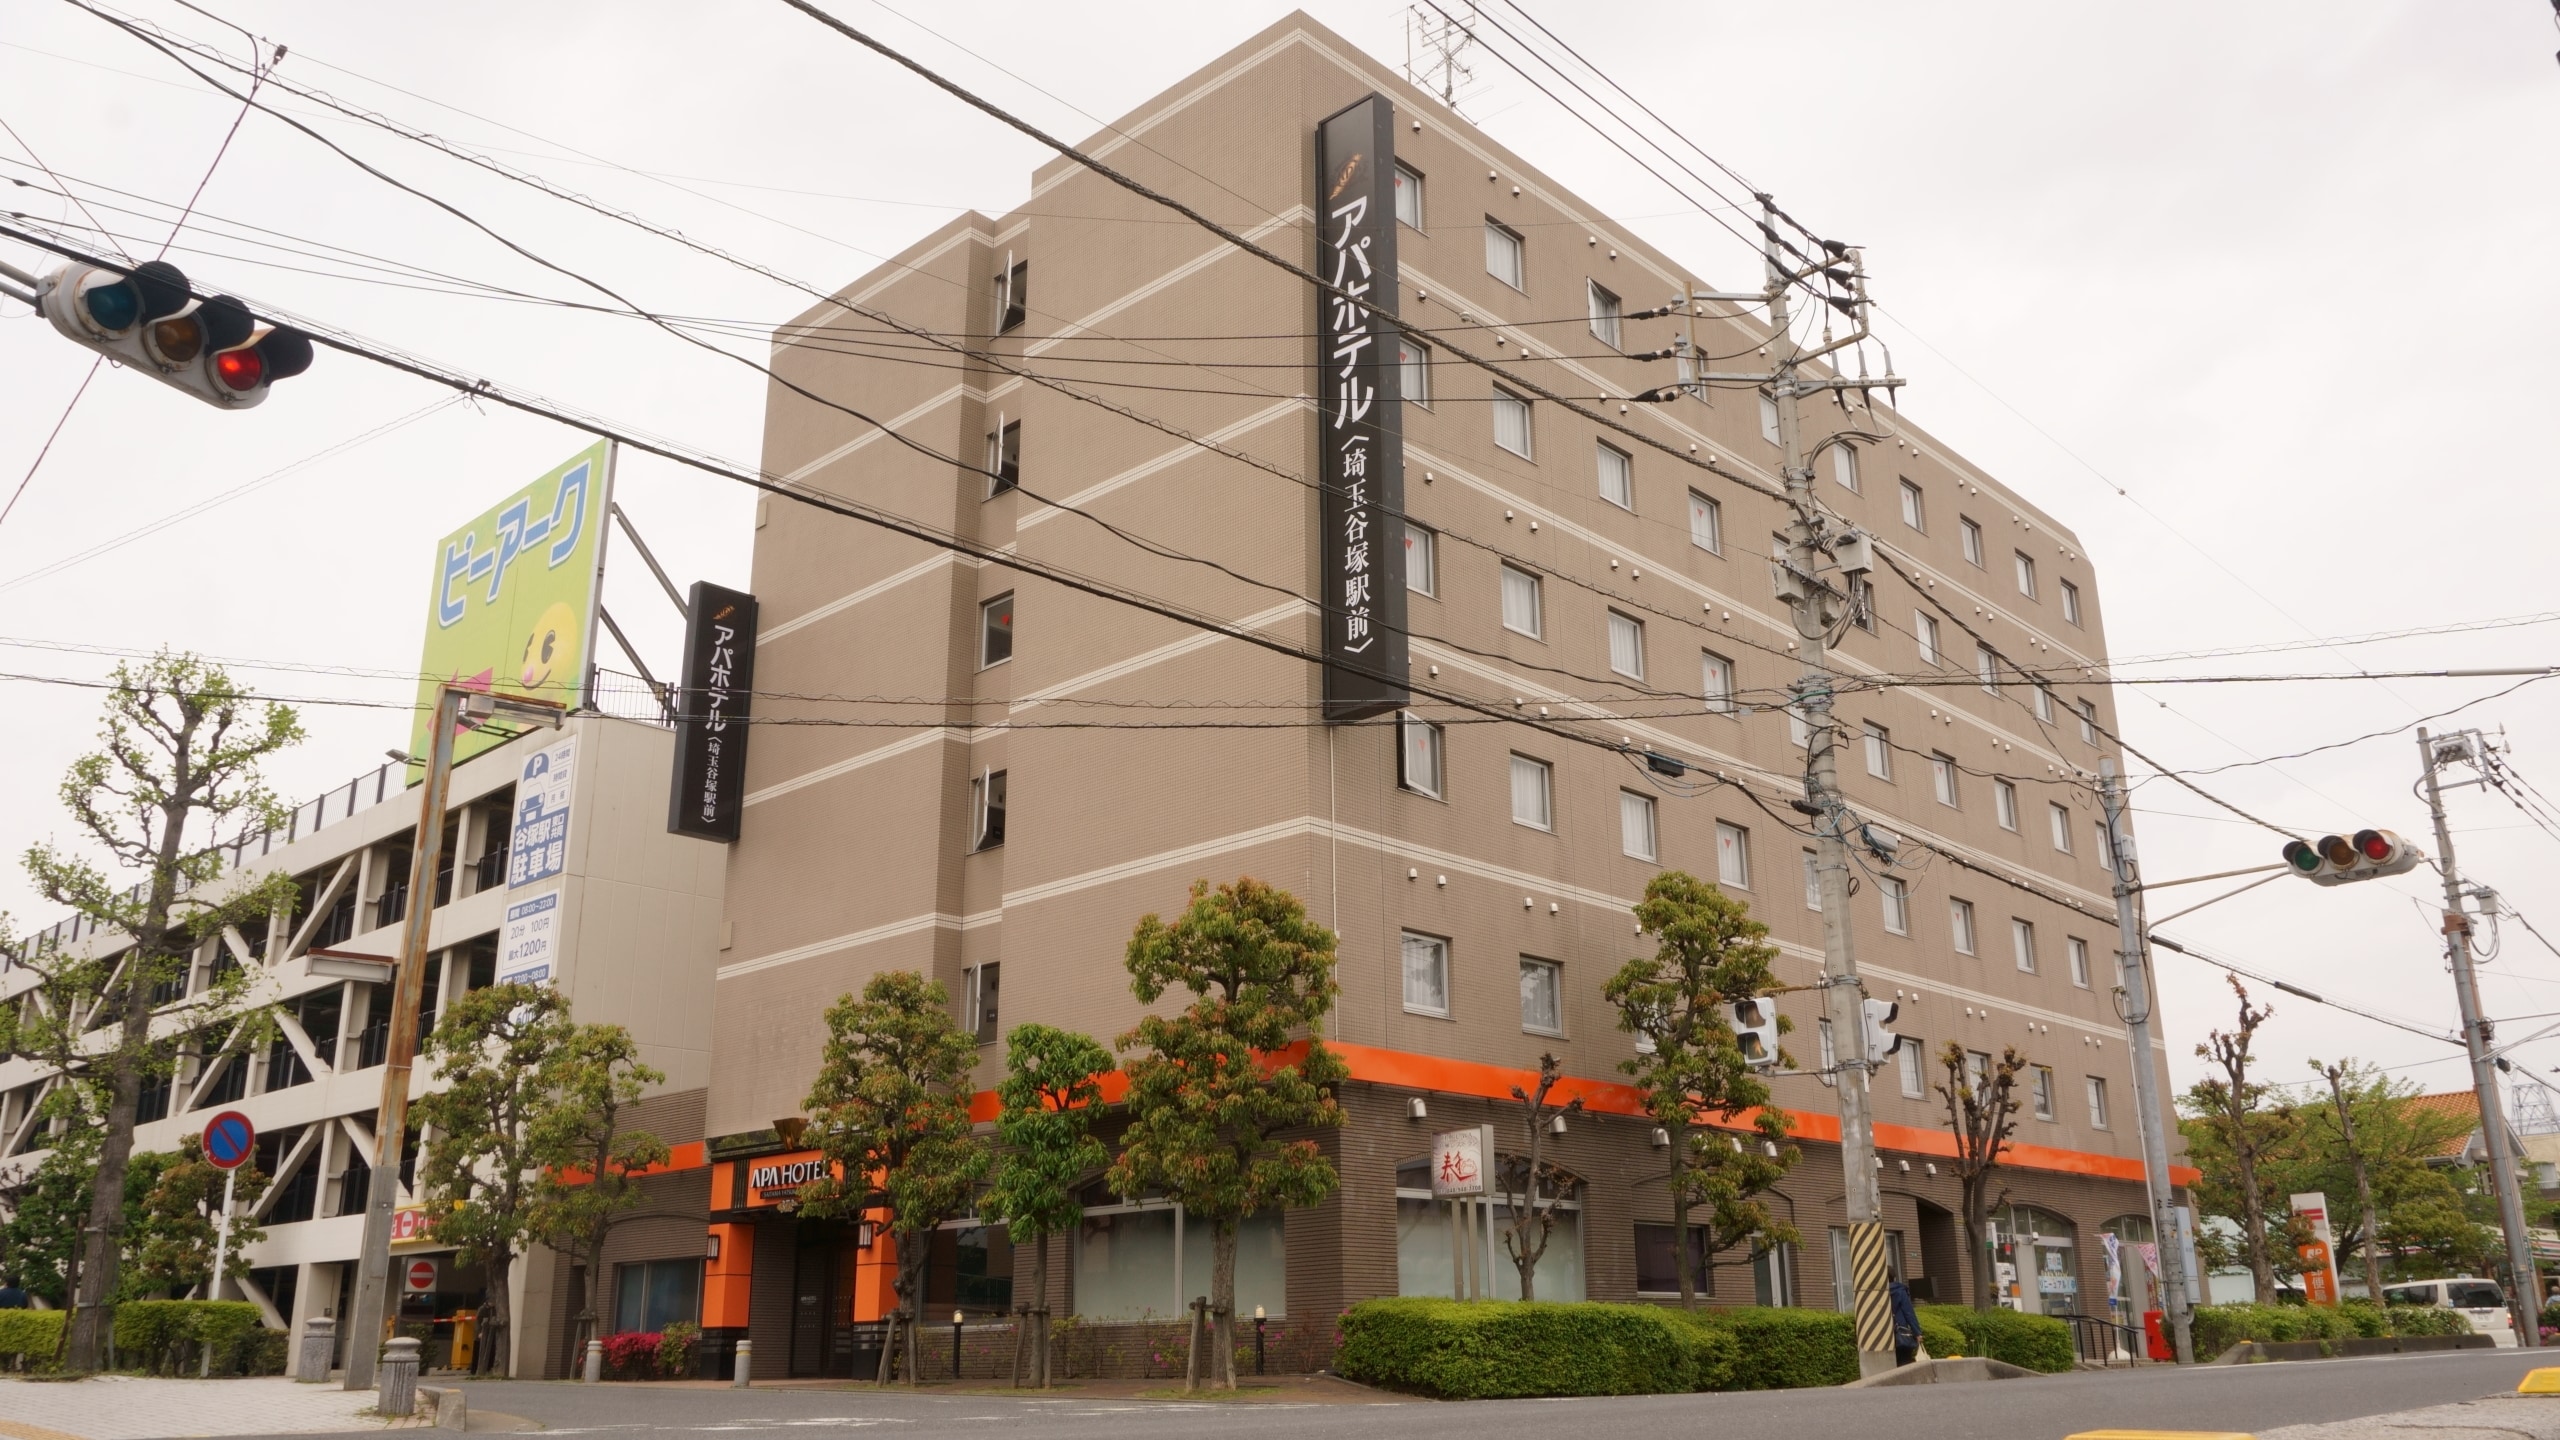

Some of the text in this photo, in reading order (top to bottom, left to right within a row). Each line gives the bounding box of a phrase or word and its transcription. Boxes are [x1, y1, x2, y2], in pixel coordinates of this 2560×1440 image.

[1331, 195, 1374, 430] アパホテル
[437, 457, 592, 627] ピーアーク
[704, 624, 735, 732] アパホテル
[532, 755, 543, 776] P
[514, 817, 552, 853] 谷塚駅
[510, 839, 563, 886] 駐車場
[751, 1166, 779, 1188] APA
